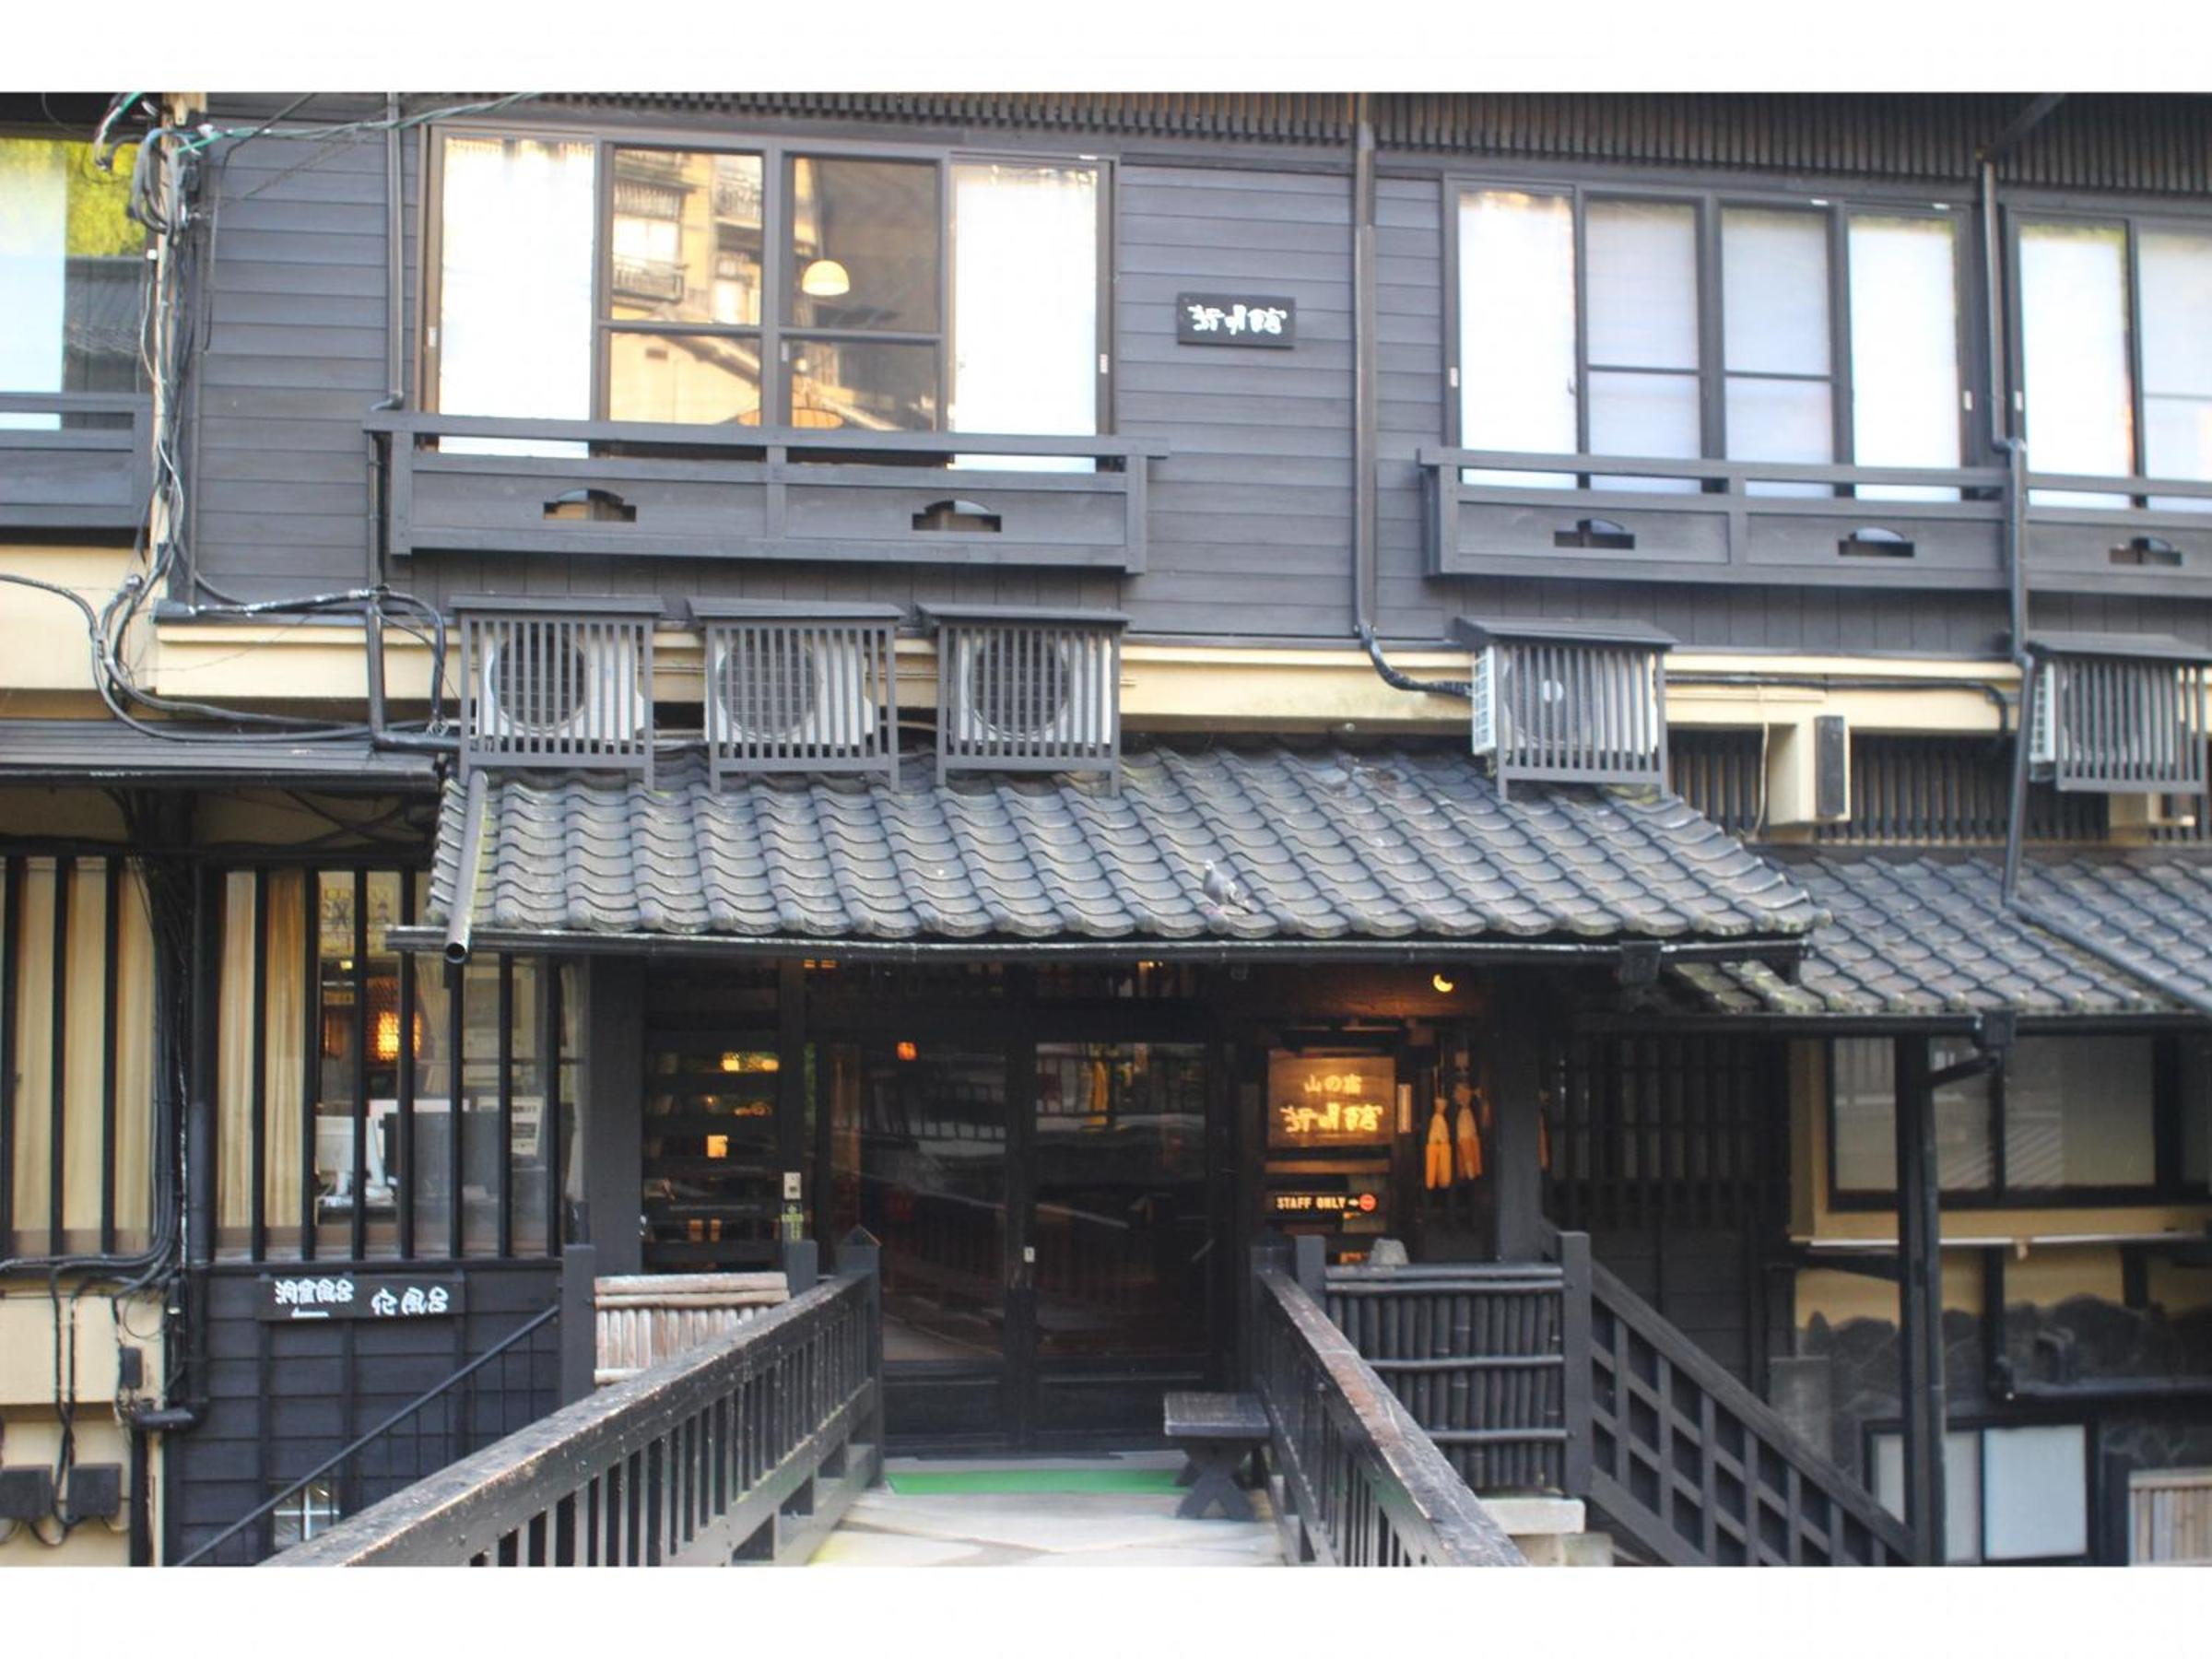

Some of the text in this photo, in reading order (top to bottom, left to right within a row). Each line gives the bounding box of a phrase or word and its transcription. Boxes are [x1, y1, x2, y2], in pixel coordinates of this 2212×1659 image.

[1304, 1074, 1363, 1095] 山の宿
[1276, 1195, 1347, 1210] STAFF ONLY
[275, 1278, 354, 1305] 洞窟風呂
